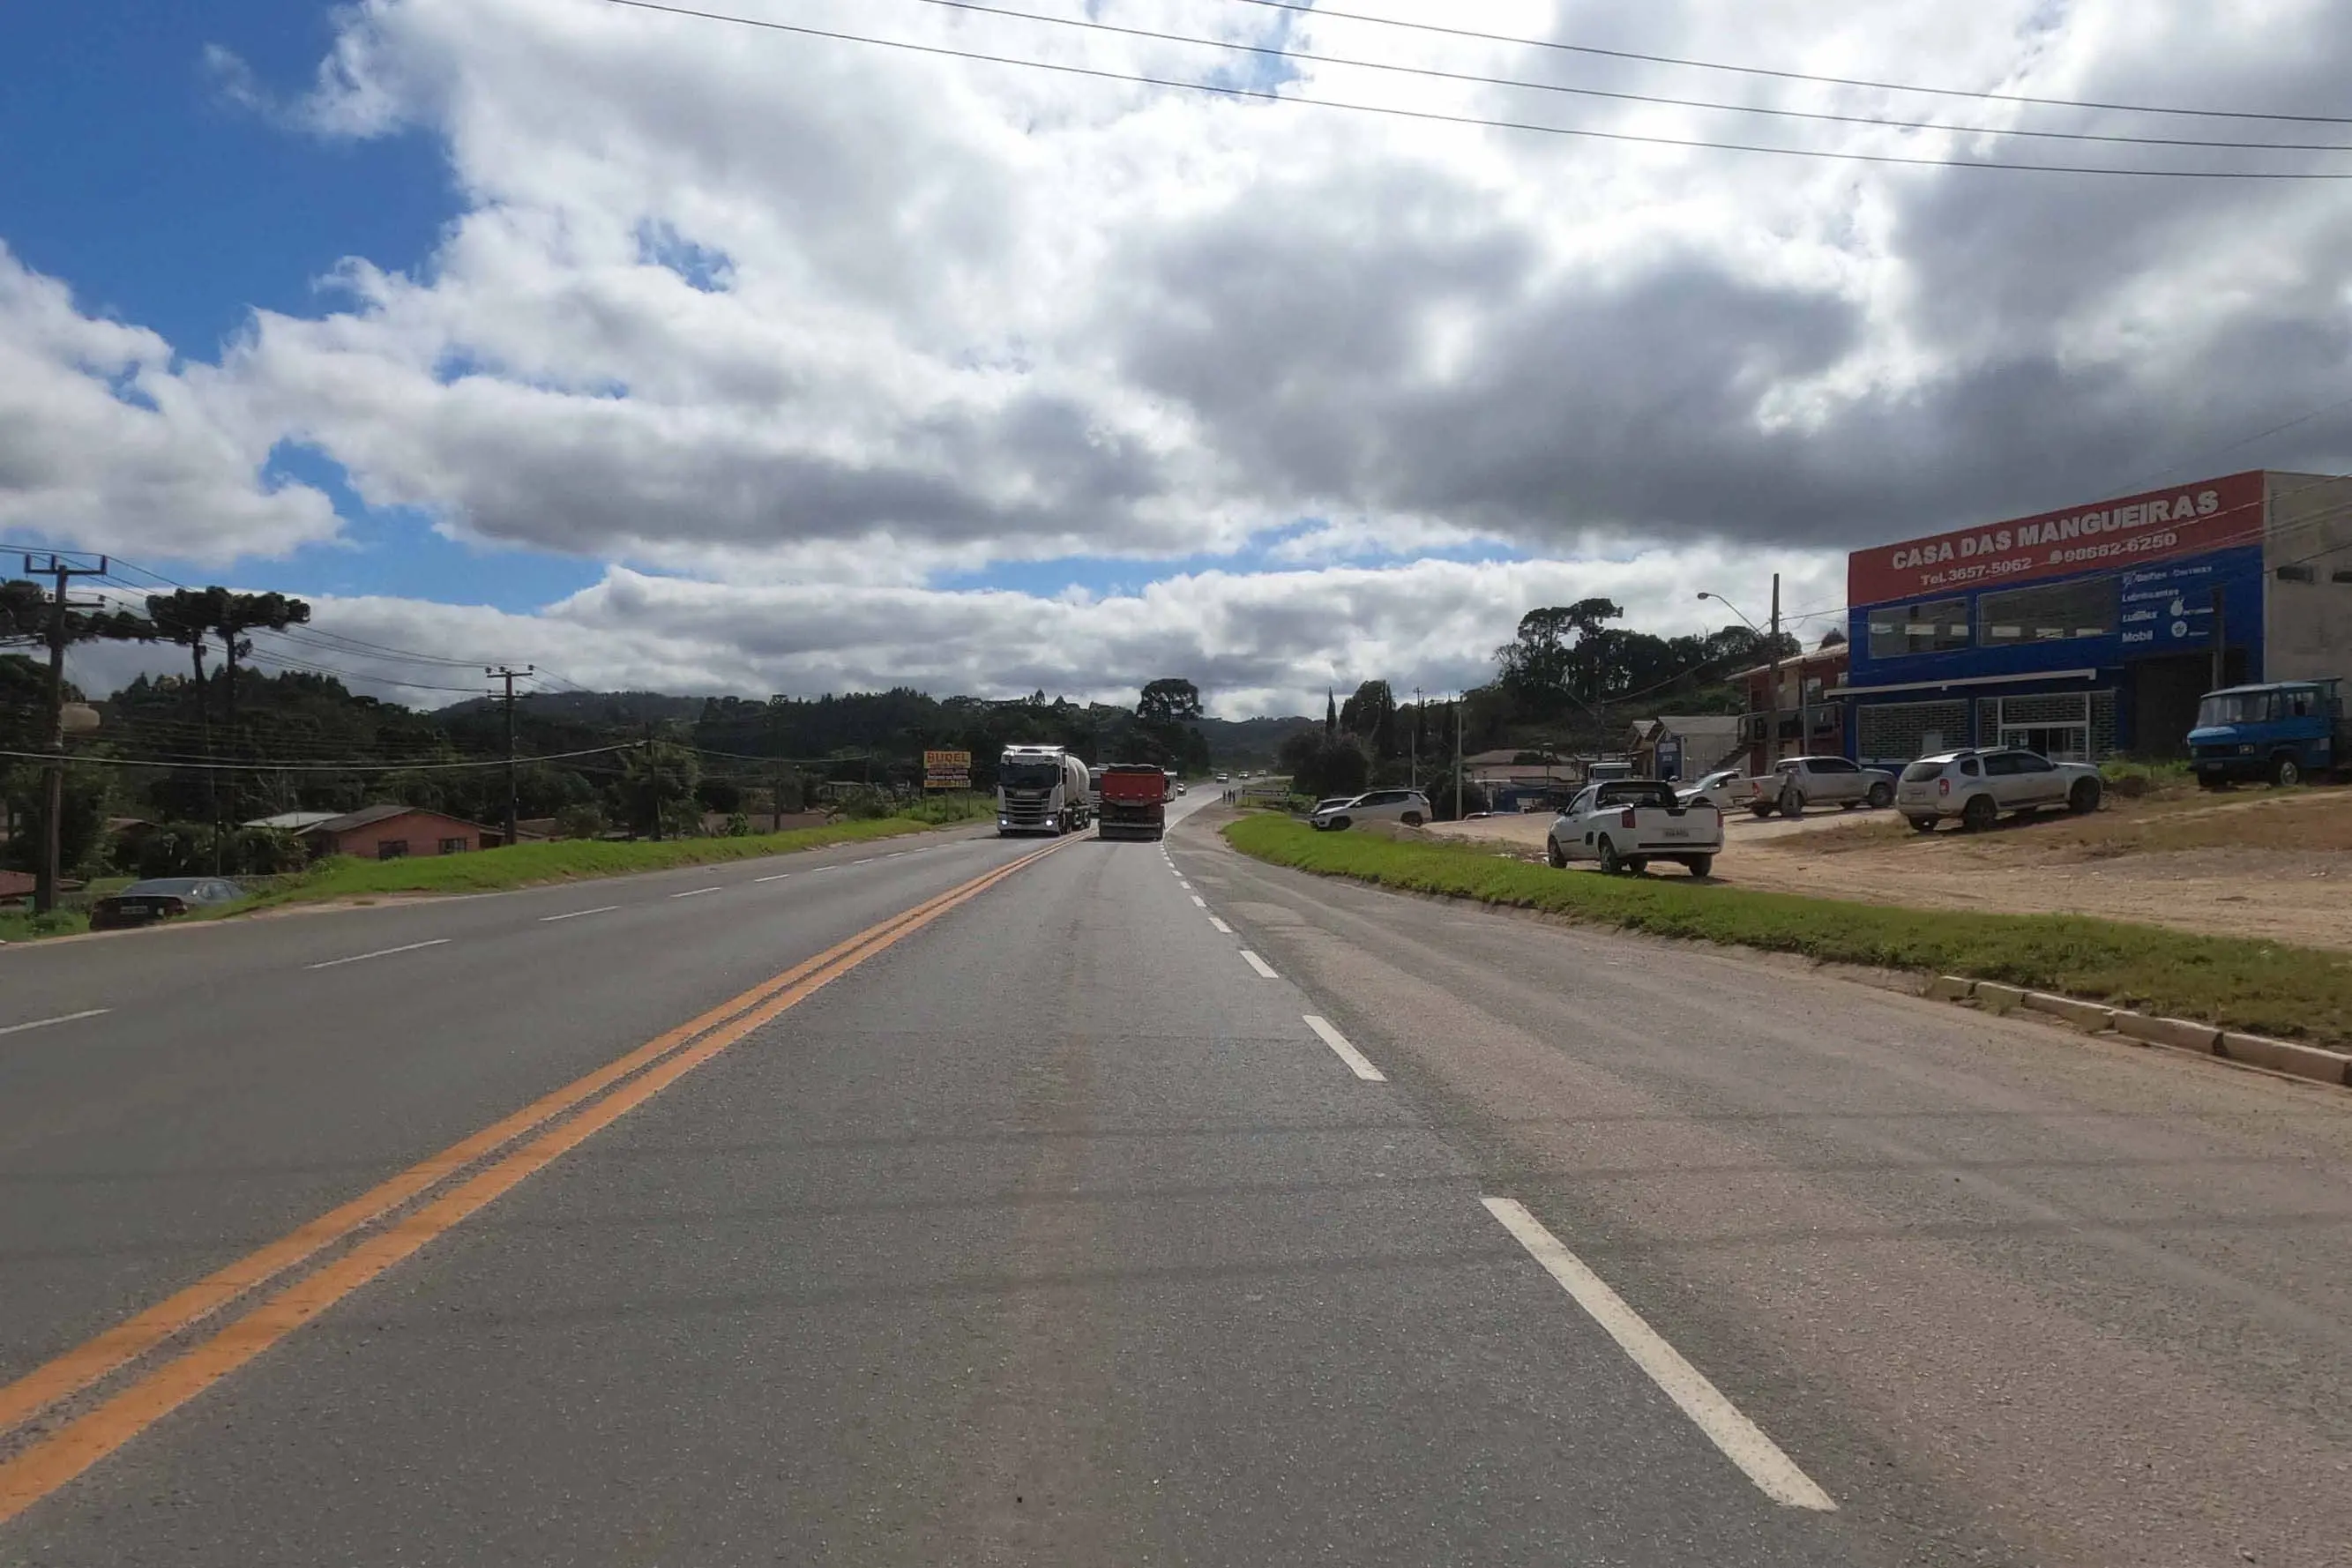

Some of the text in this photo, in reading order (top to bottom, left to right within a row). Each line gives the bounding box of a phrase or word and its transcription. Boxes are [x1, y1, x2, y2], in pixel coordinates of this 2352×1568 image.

[1892, 490, 2219, 570] CASA DAS MANGUEIRAS
[2122, 630, 2154, 642] Mobil
